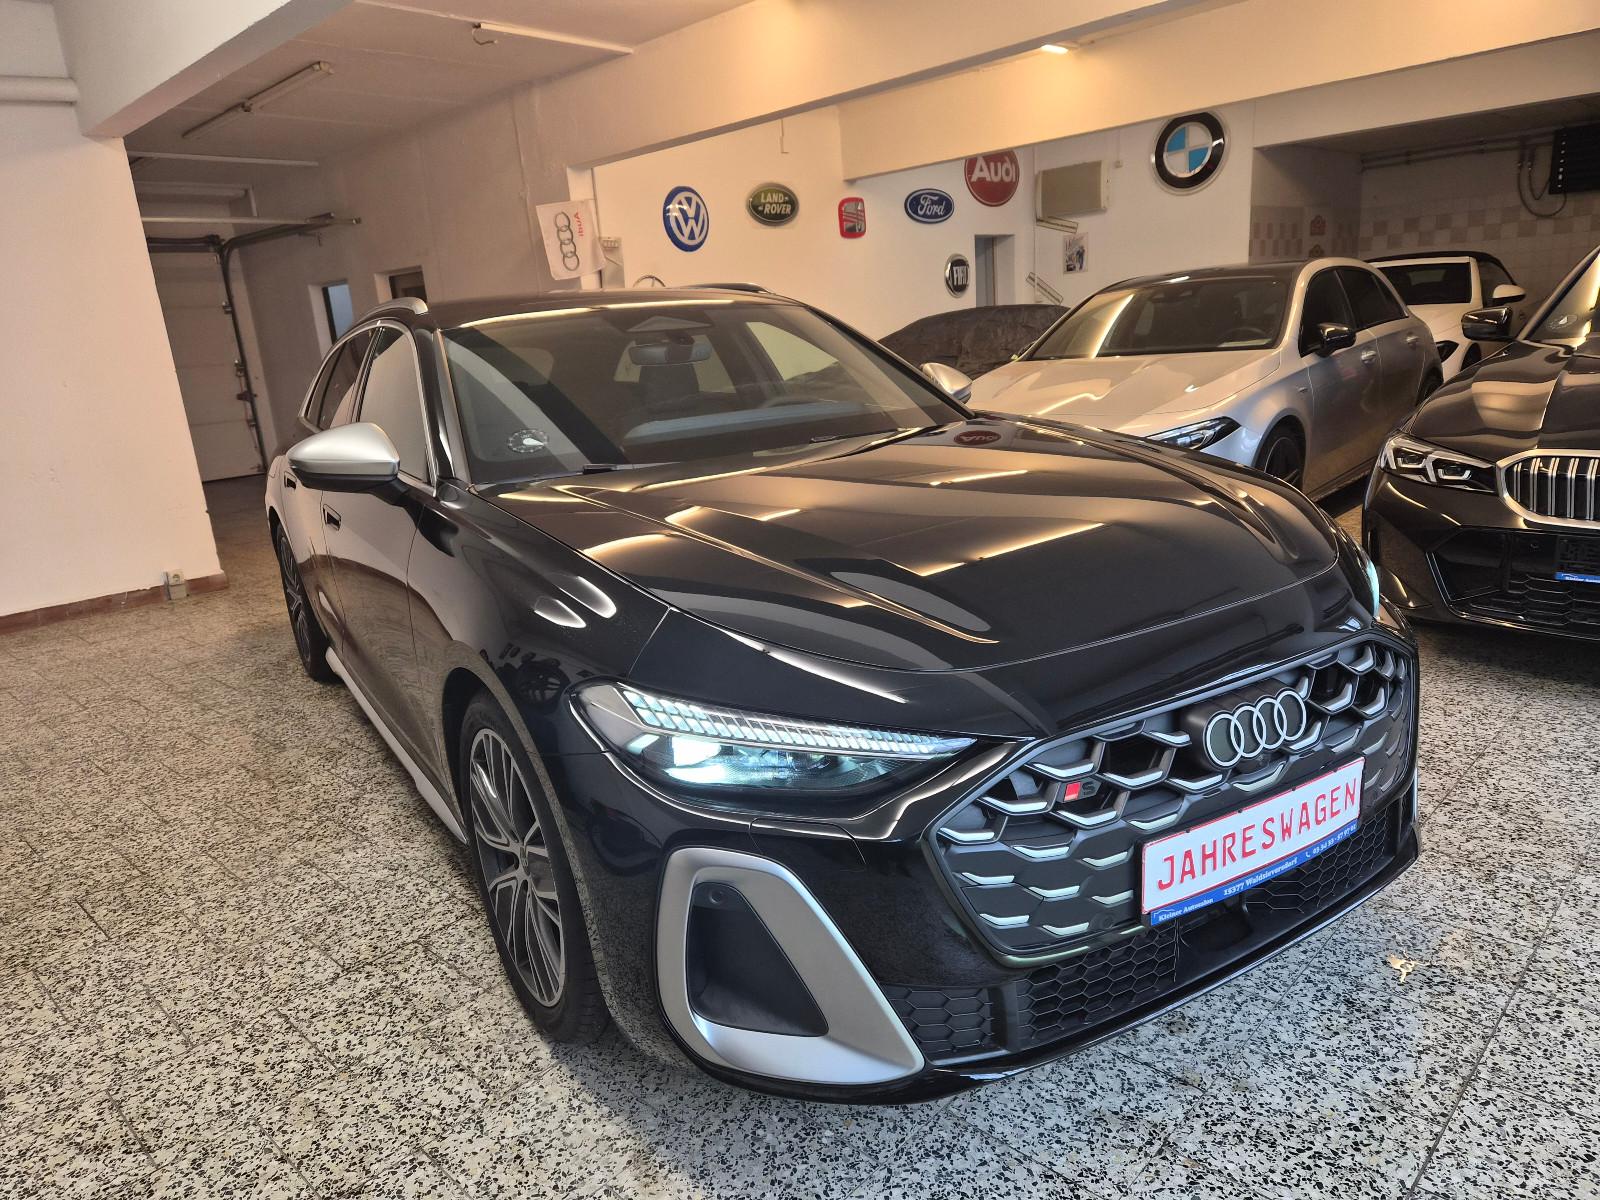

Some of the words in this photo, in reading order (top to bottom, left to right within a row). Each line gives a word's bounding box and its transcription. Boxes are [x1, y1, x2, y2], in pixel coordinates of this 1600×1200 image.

[970, 154, 1017, 182] Audi
[760, 192, 785, 203] LAND
[917, 194, 946, 216] Ford
[763, 203, 792, 215] ROVER
[1157, 777, 1357, 891] JAHRESWAGEN
